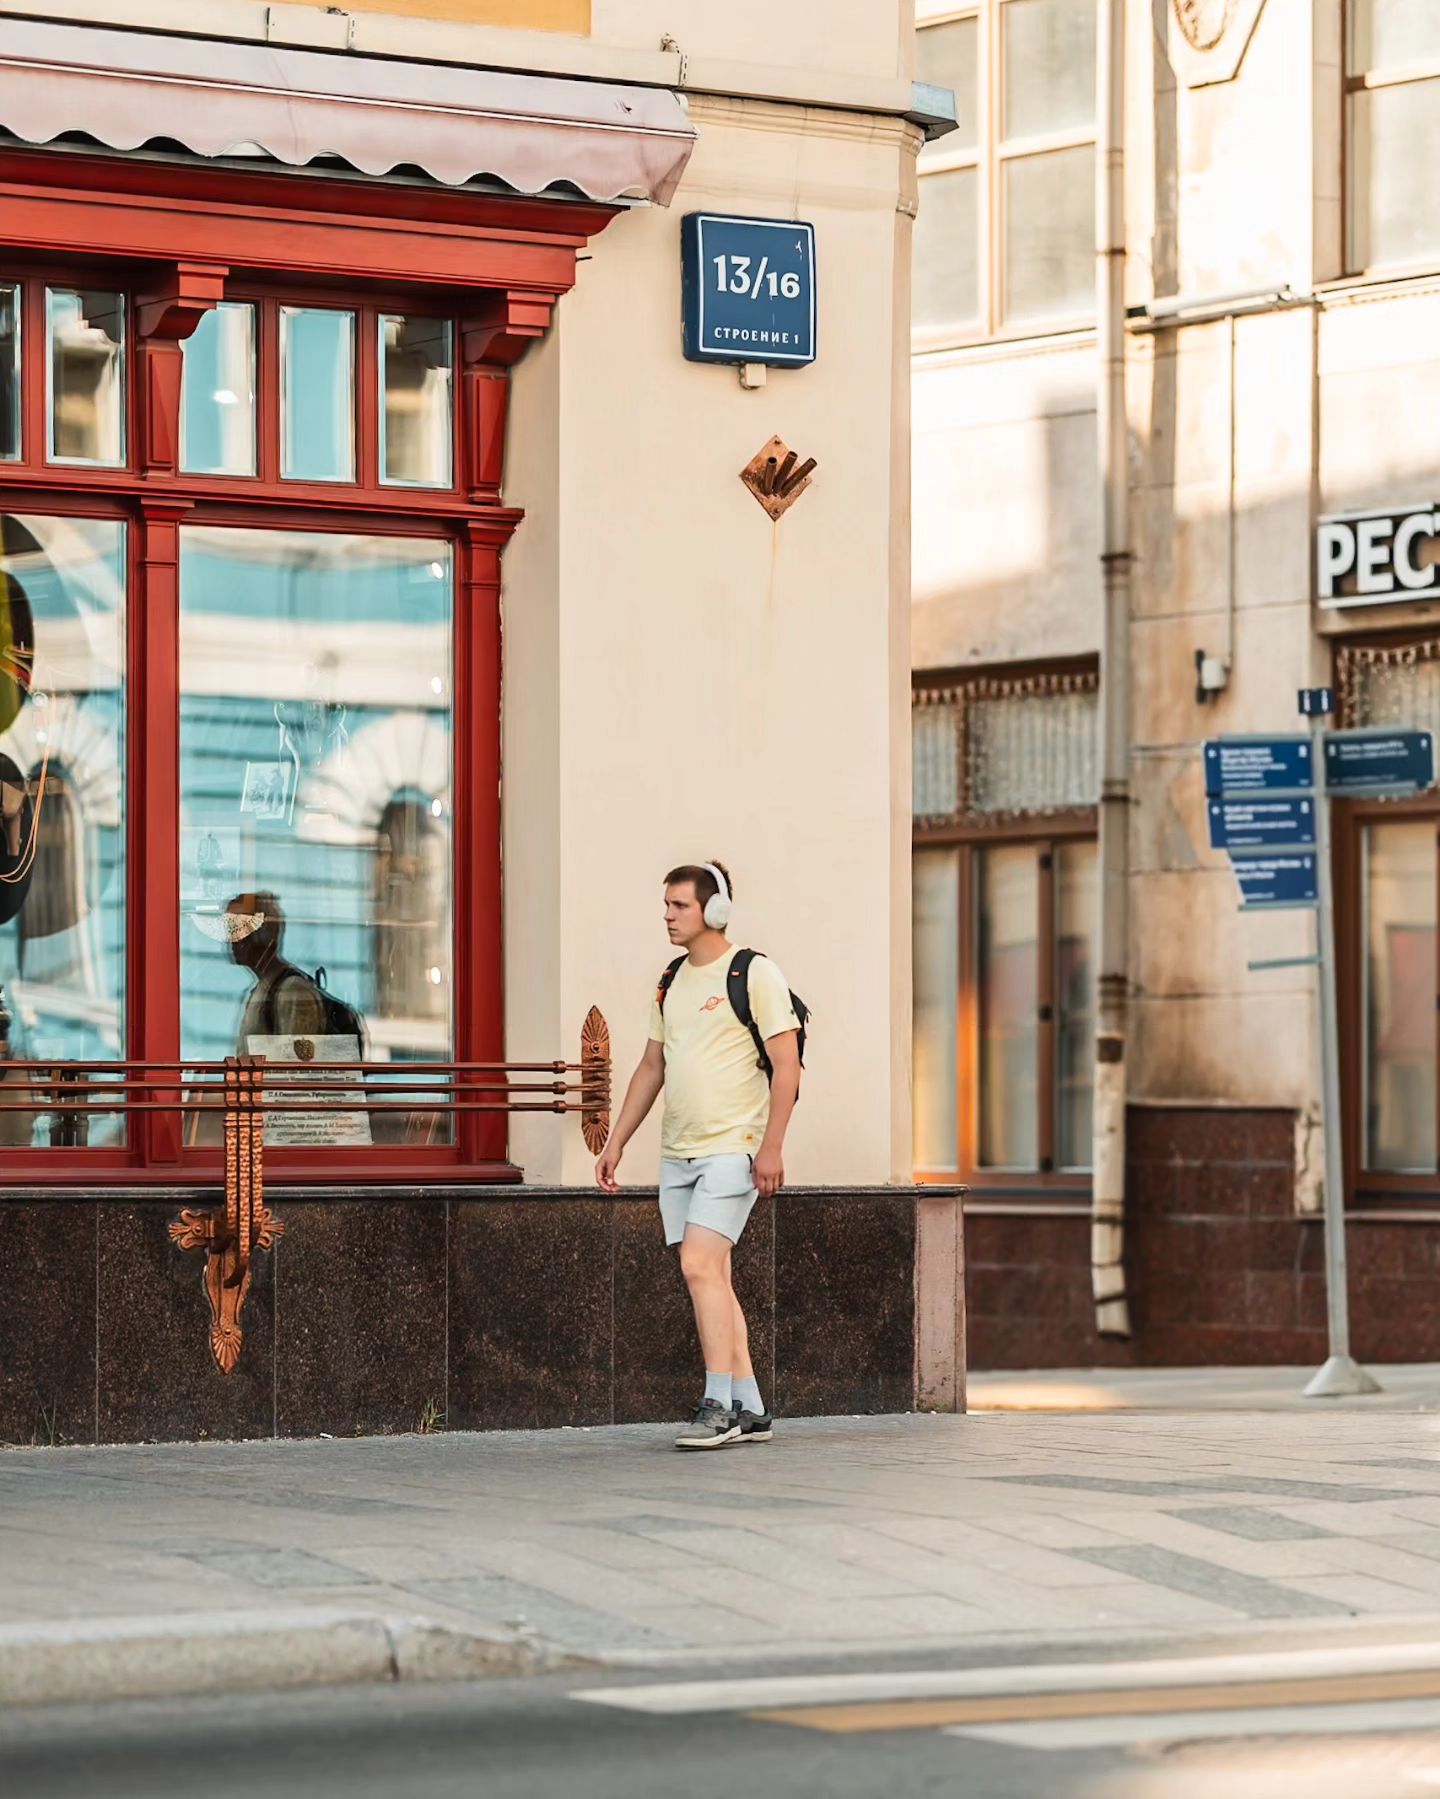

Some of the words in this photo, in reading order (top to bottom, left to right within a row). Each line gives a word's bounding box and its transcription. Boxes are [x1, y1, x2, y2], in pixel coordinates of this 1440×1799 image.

[713, 254, 801, 300] 13/16
[714, 327, 789, 344] СТРОЕНИЕ
[794, 334, 799, 345] 1
[1317, 511, 1440, 598] РЕС
